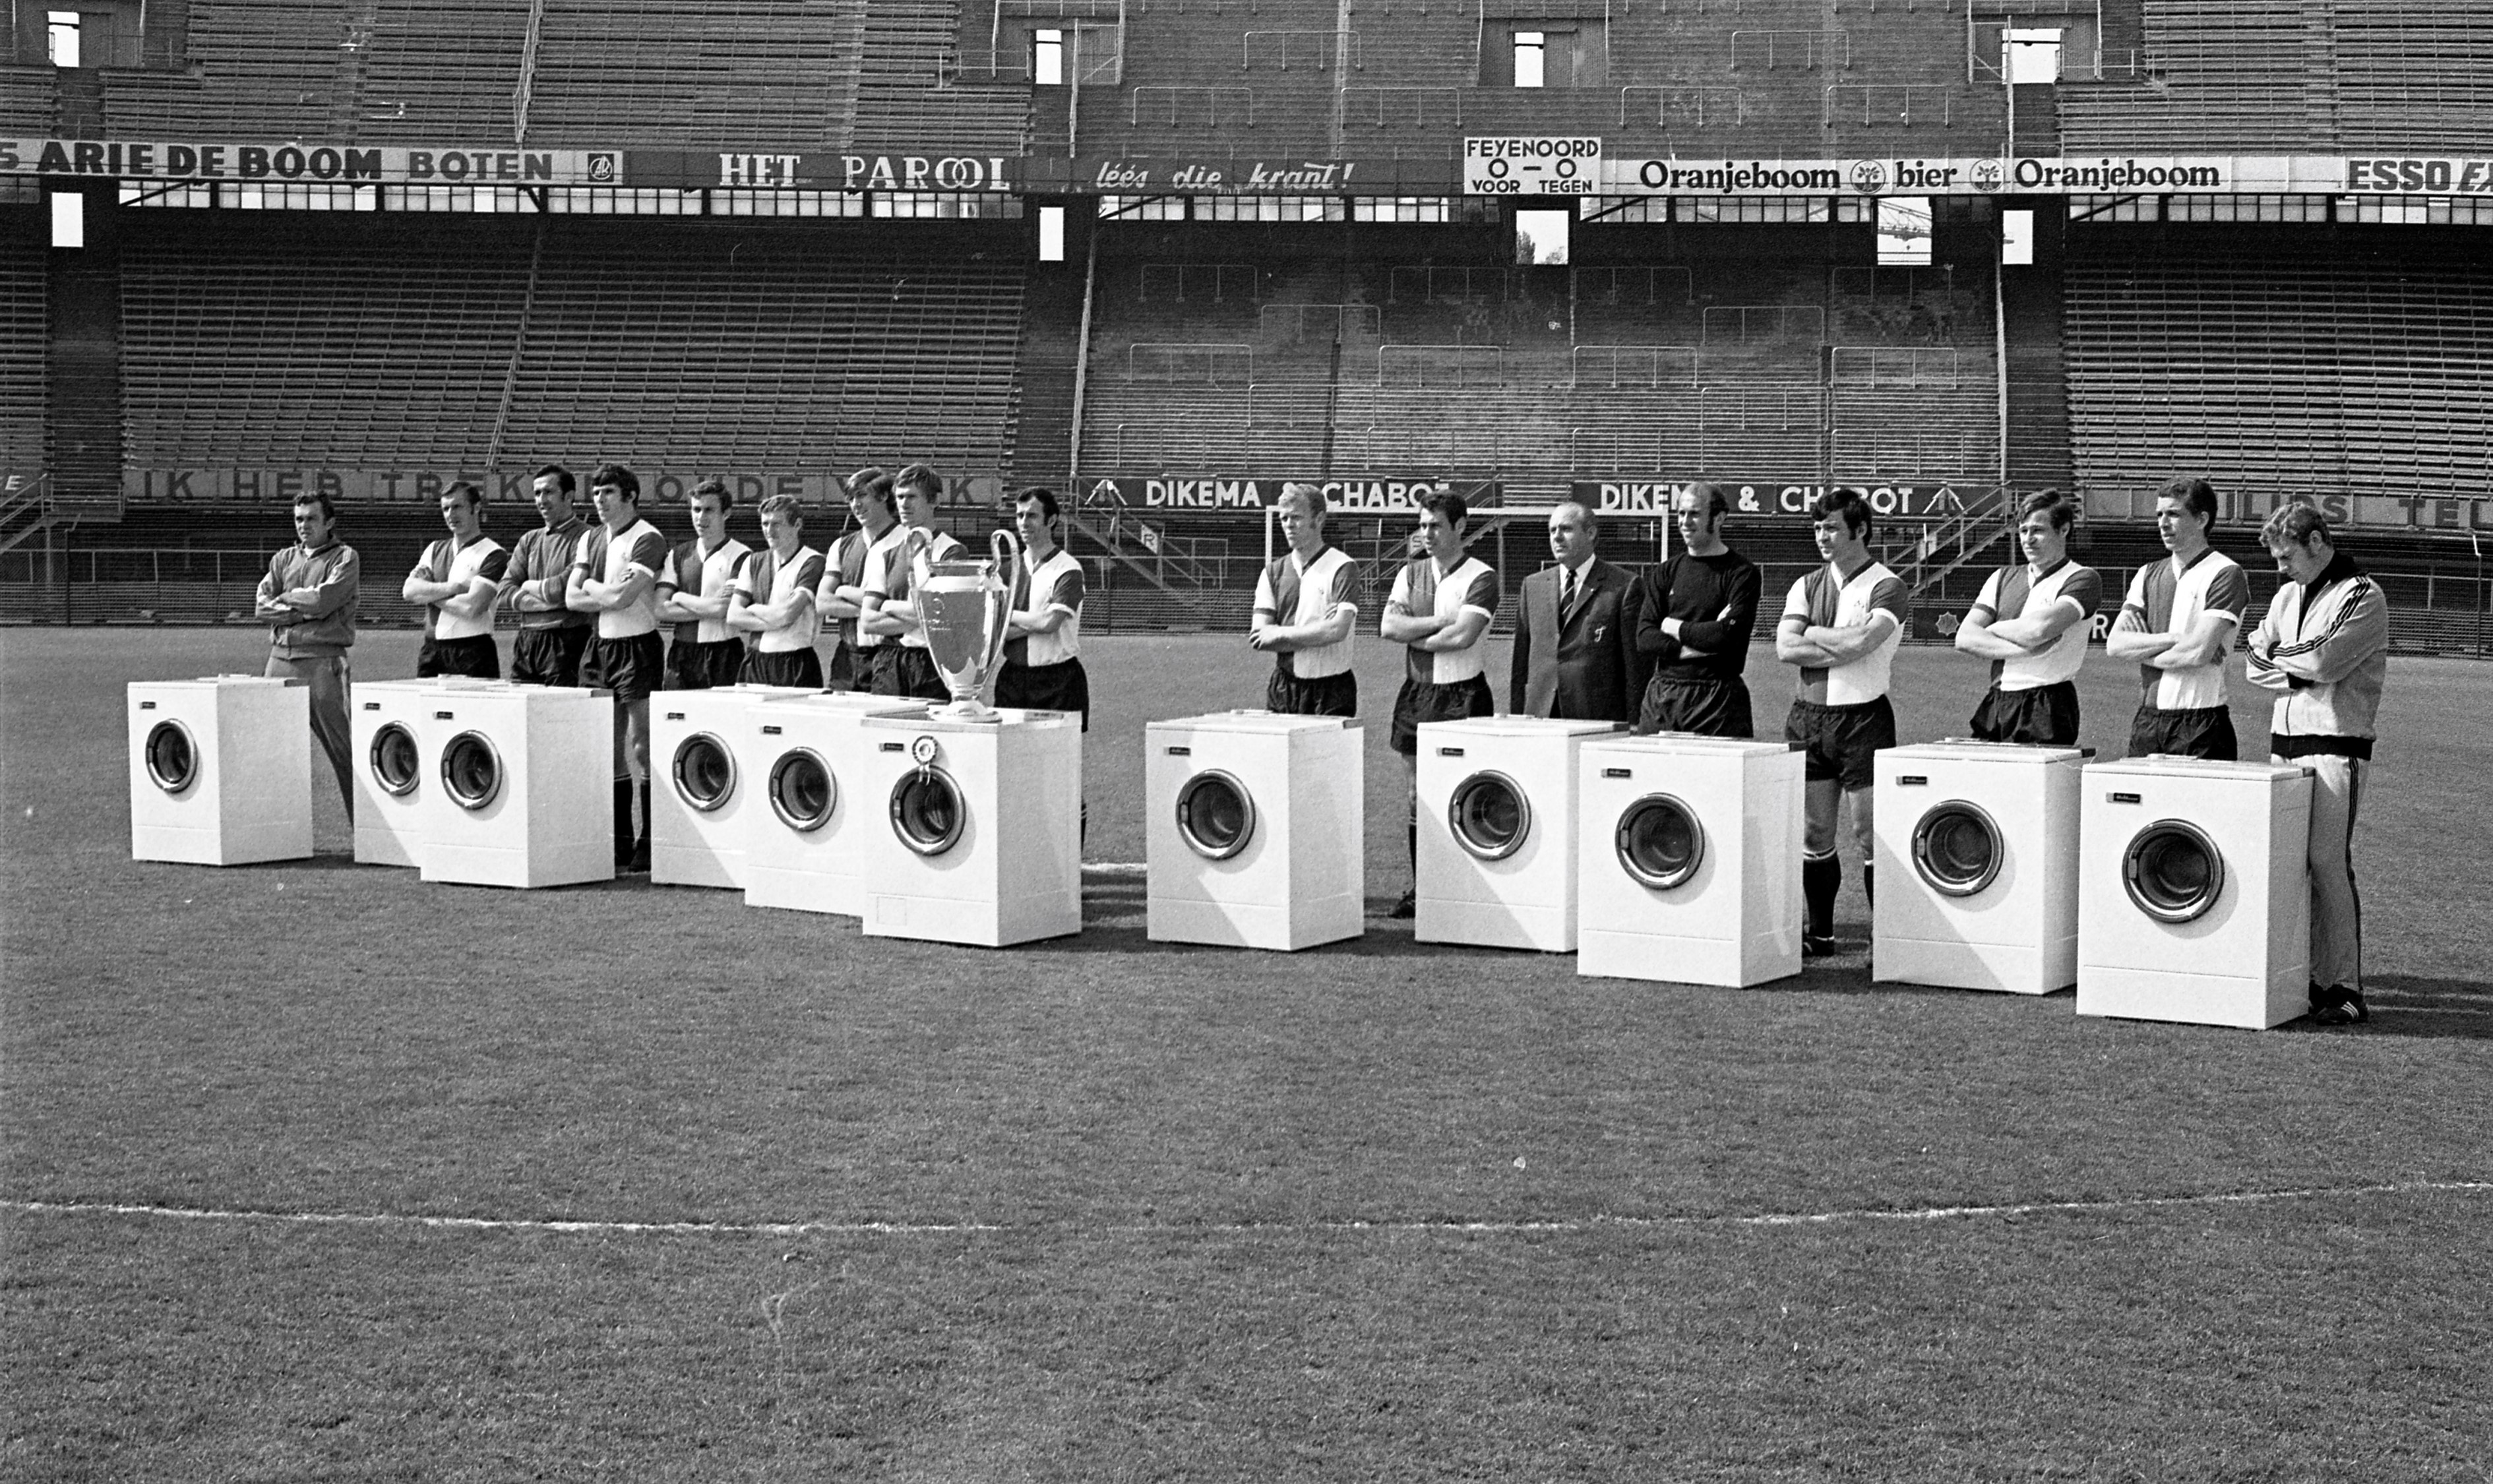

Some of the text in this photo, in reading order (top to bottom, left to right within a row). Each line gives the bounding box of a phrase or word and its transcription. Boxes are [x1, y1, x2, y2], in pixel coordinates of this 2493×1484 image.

[36, 141, 153, 174] ARIE
[168, 146, 225, 176] DE
[239, 147, 383, 179] BOOM
[409, 152, 552, 181] BOTEN
[1467, 140, 1599, 157] FEYENOORD
[720, 154, 1010, 191] HET PAROOL
[1173, 166, 1223, 189] die
[1472, 179, 1592, 193] VOOR TEGEN
[1640, 160, 1957, 194] Oranjeboom bier
[2015, 159, 2220, 192] Oranjeboom
[2349, 160, 2451, 191] ESSO
[144, 472, 194, 499] IK
[233, 472, 344, 501] HEB
[1146, 481, 1450, 509] DIKEMA CHABO
[1601, 483, 1913, 514] DIKE & CHOT
[1143, 533, 1155, 547] R
